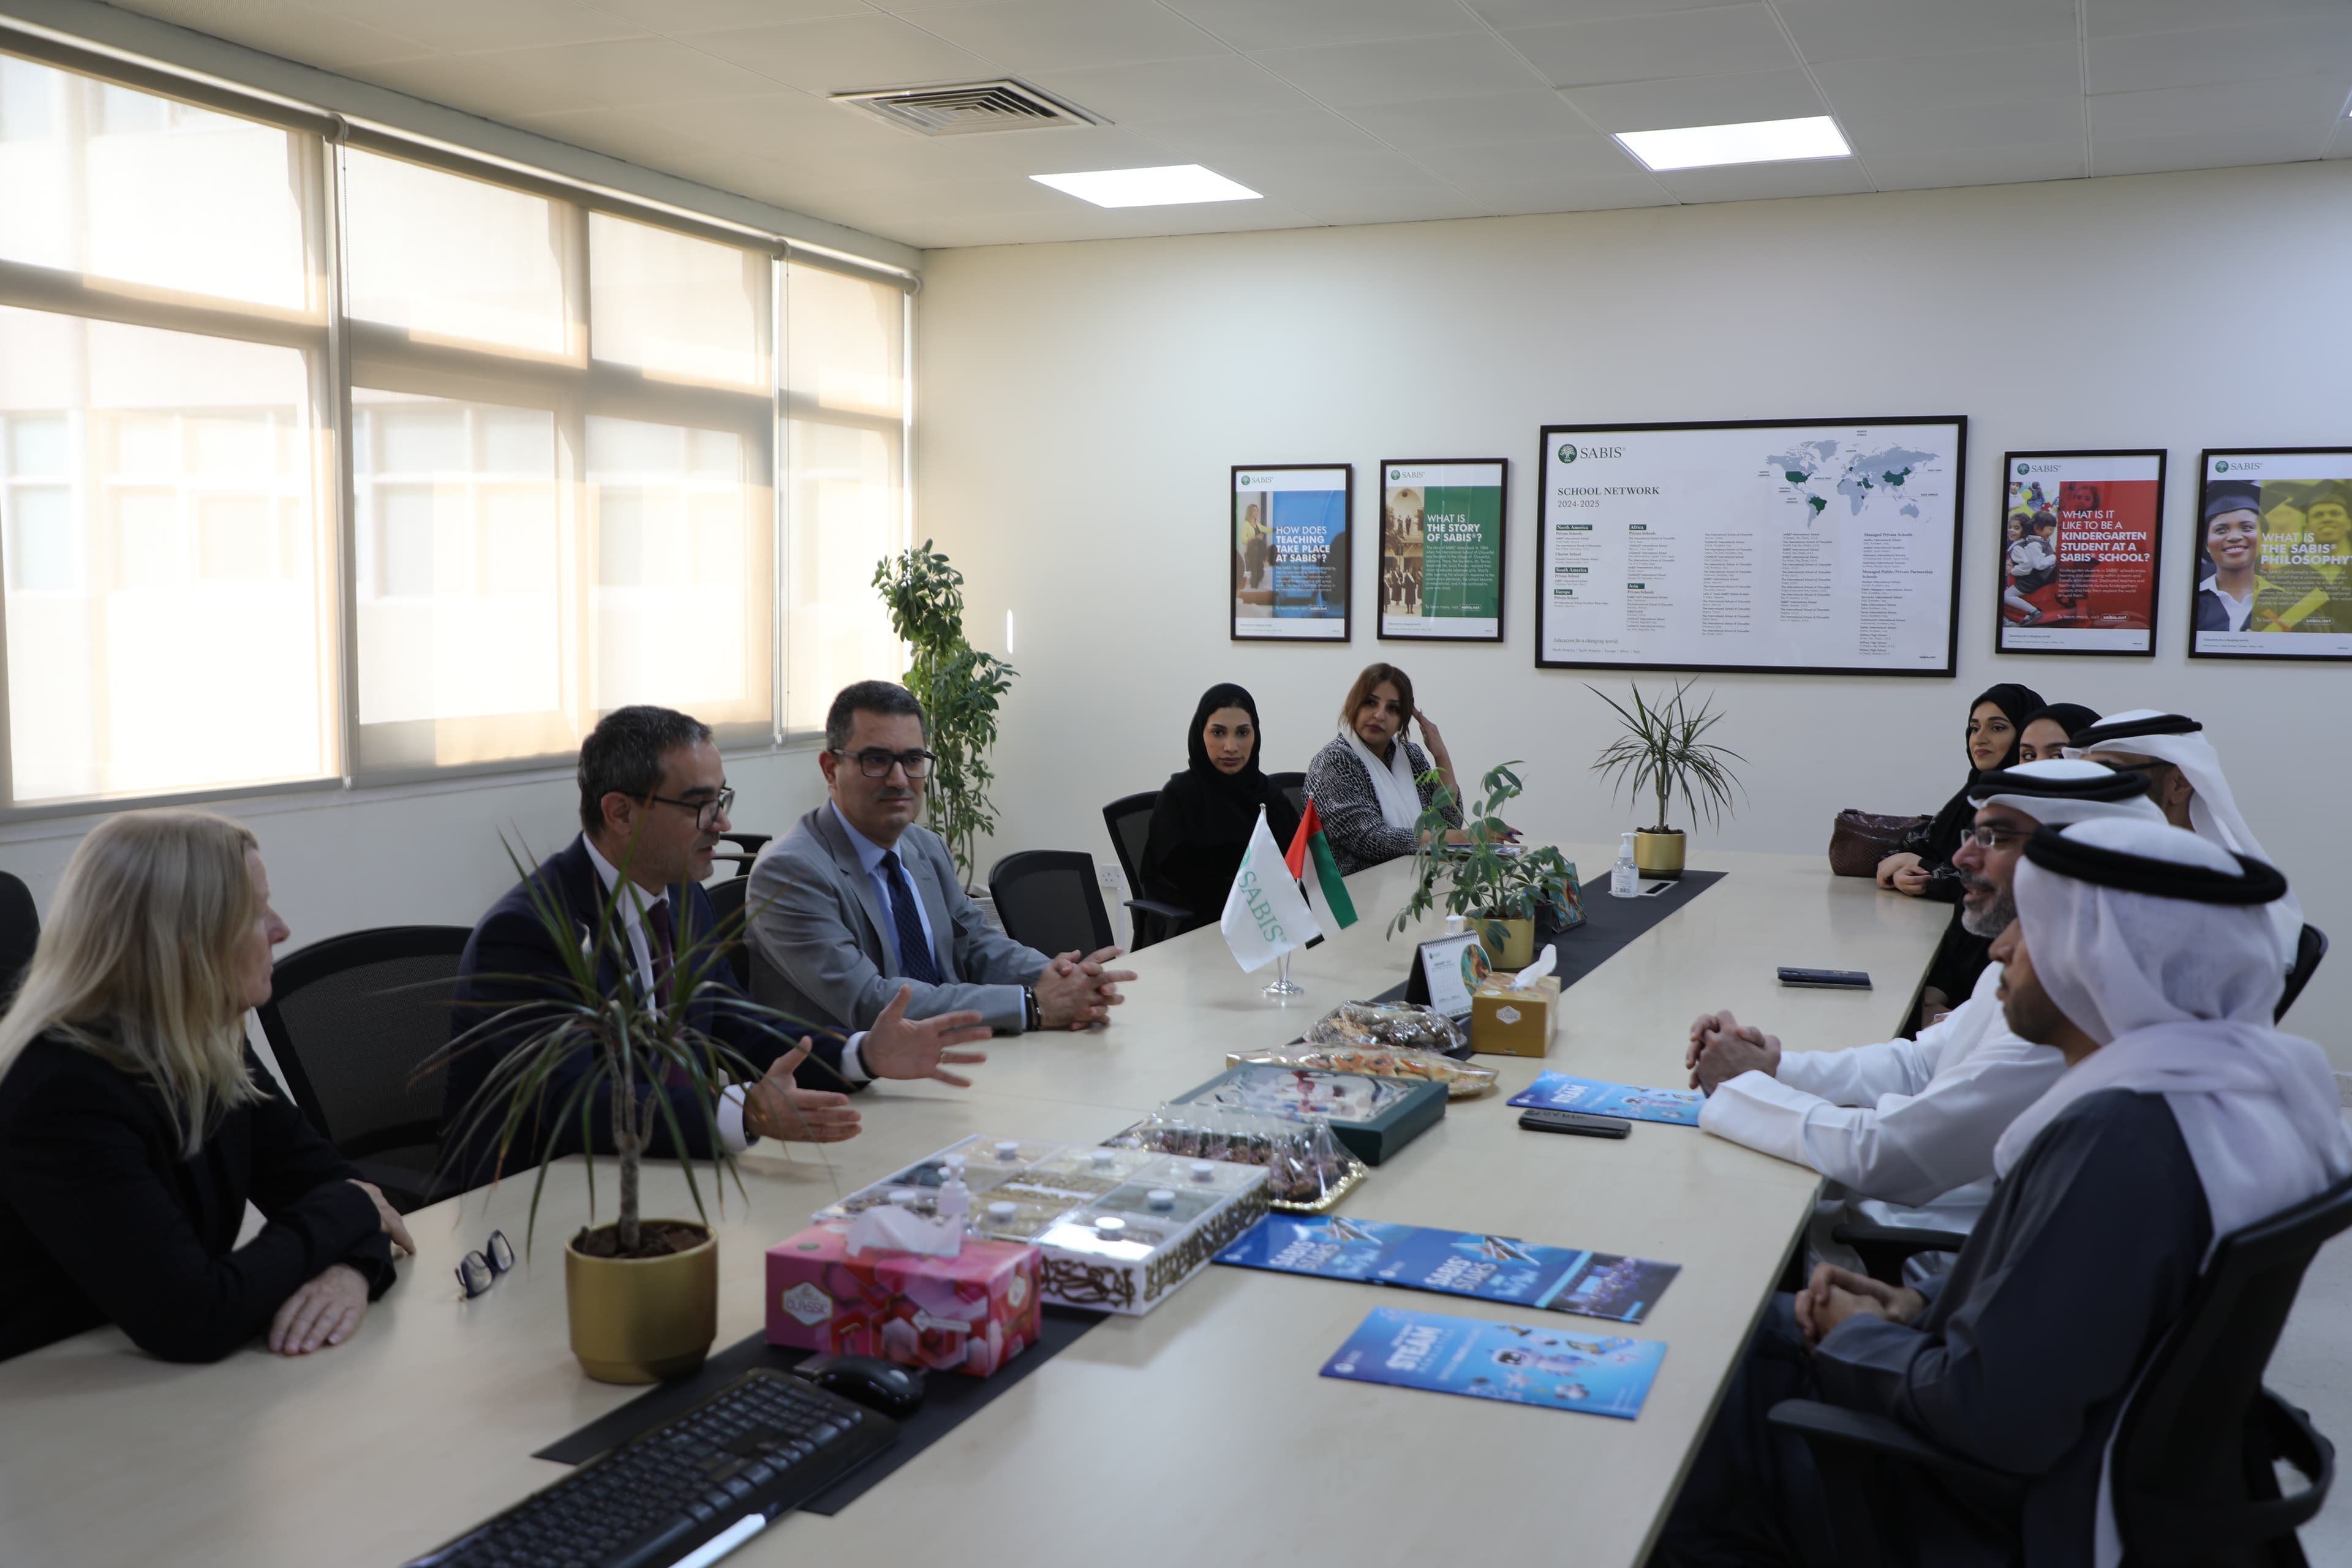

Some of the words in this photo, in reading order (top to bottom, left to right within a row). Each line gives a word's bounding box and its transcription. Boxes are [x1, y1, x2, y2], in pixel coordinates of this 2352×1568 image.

[1558, 487, 1601, 496] SCHOOL
[1604, 486, 1659, 495] NETWORK
[1427, 524, 1446, 532] THE
[1449, 524, 1480, 532] STORY
[1276, 535, 1324, 544] TEACHING
[1427, 533, 1440, 541] OF
[2062, 532, 2147, 540] KINDERGARTEN
[2262, 533, 2299, 542] WHAT
[2304, 533, 2315, 542] IS
[2060, 543, 2110, 551] STUDENT
[2112, 543, 2126, 551] AT
[2127, 543, 2136, 551] A
[2261, 544, 2287, 554] THE
[1276, 554, 1287, 562] AT
[2098, 553, 2150, 562] SCHOOL?
